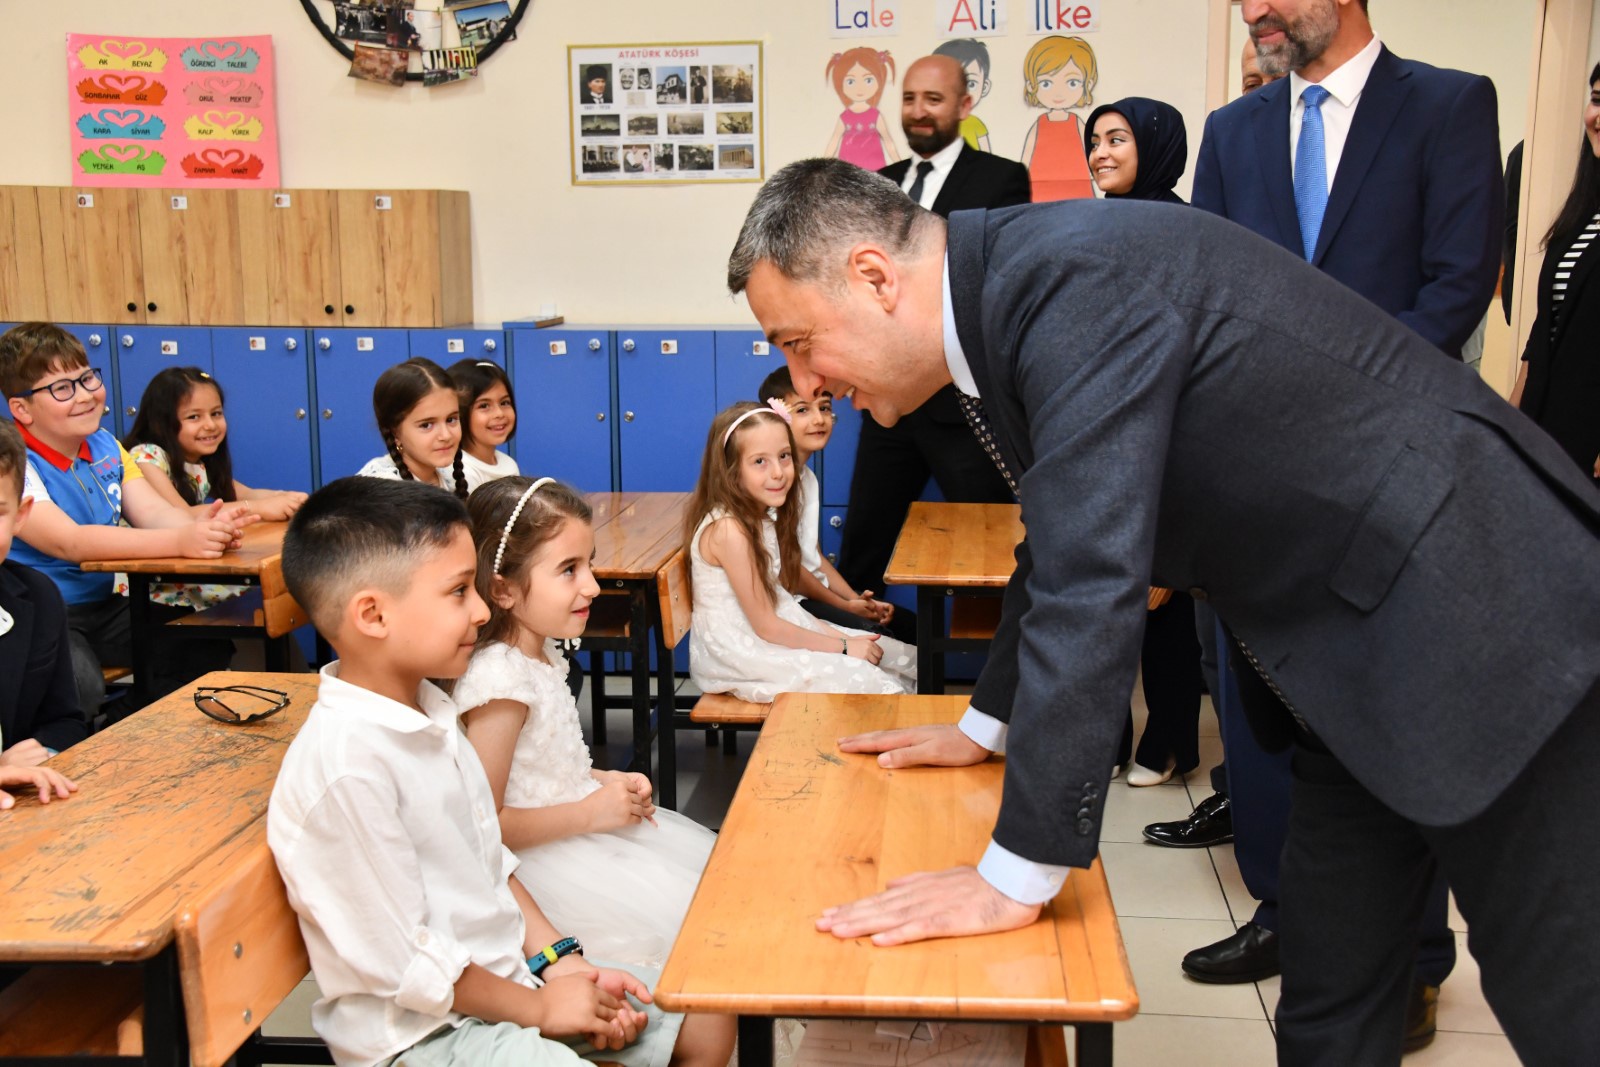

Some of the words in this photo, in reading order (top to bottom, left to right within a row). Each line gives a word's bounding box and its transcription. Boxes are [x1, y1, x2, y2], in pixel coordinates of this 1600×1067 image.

[948, 0, 995, 32] Ali
[618, 48, 661, 59] ATATÜRK
[664, 47, 699, 59] KÖŞESİ
[132, 60, 153, 68] BEYAZ
[190, 58, 216, 68] ÖĞRENCİ
[135, 92, 148, 101] GÜZ
[231, 128, 250, 136] YÜREK
